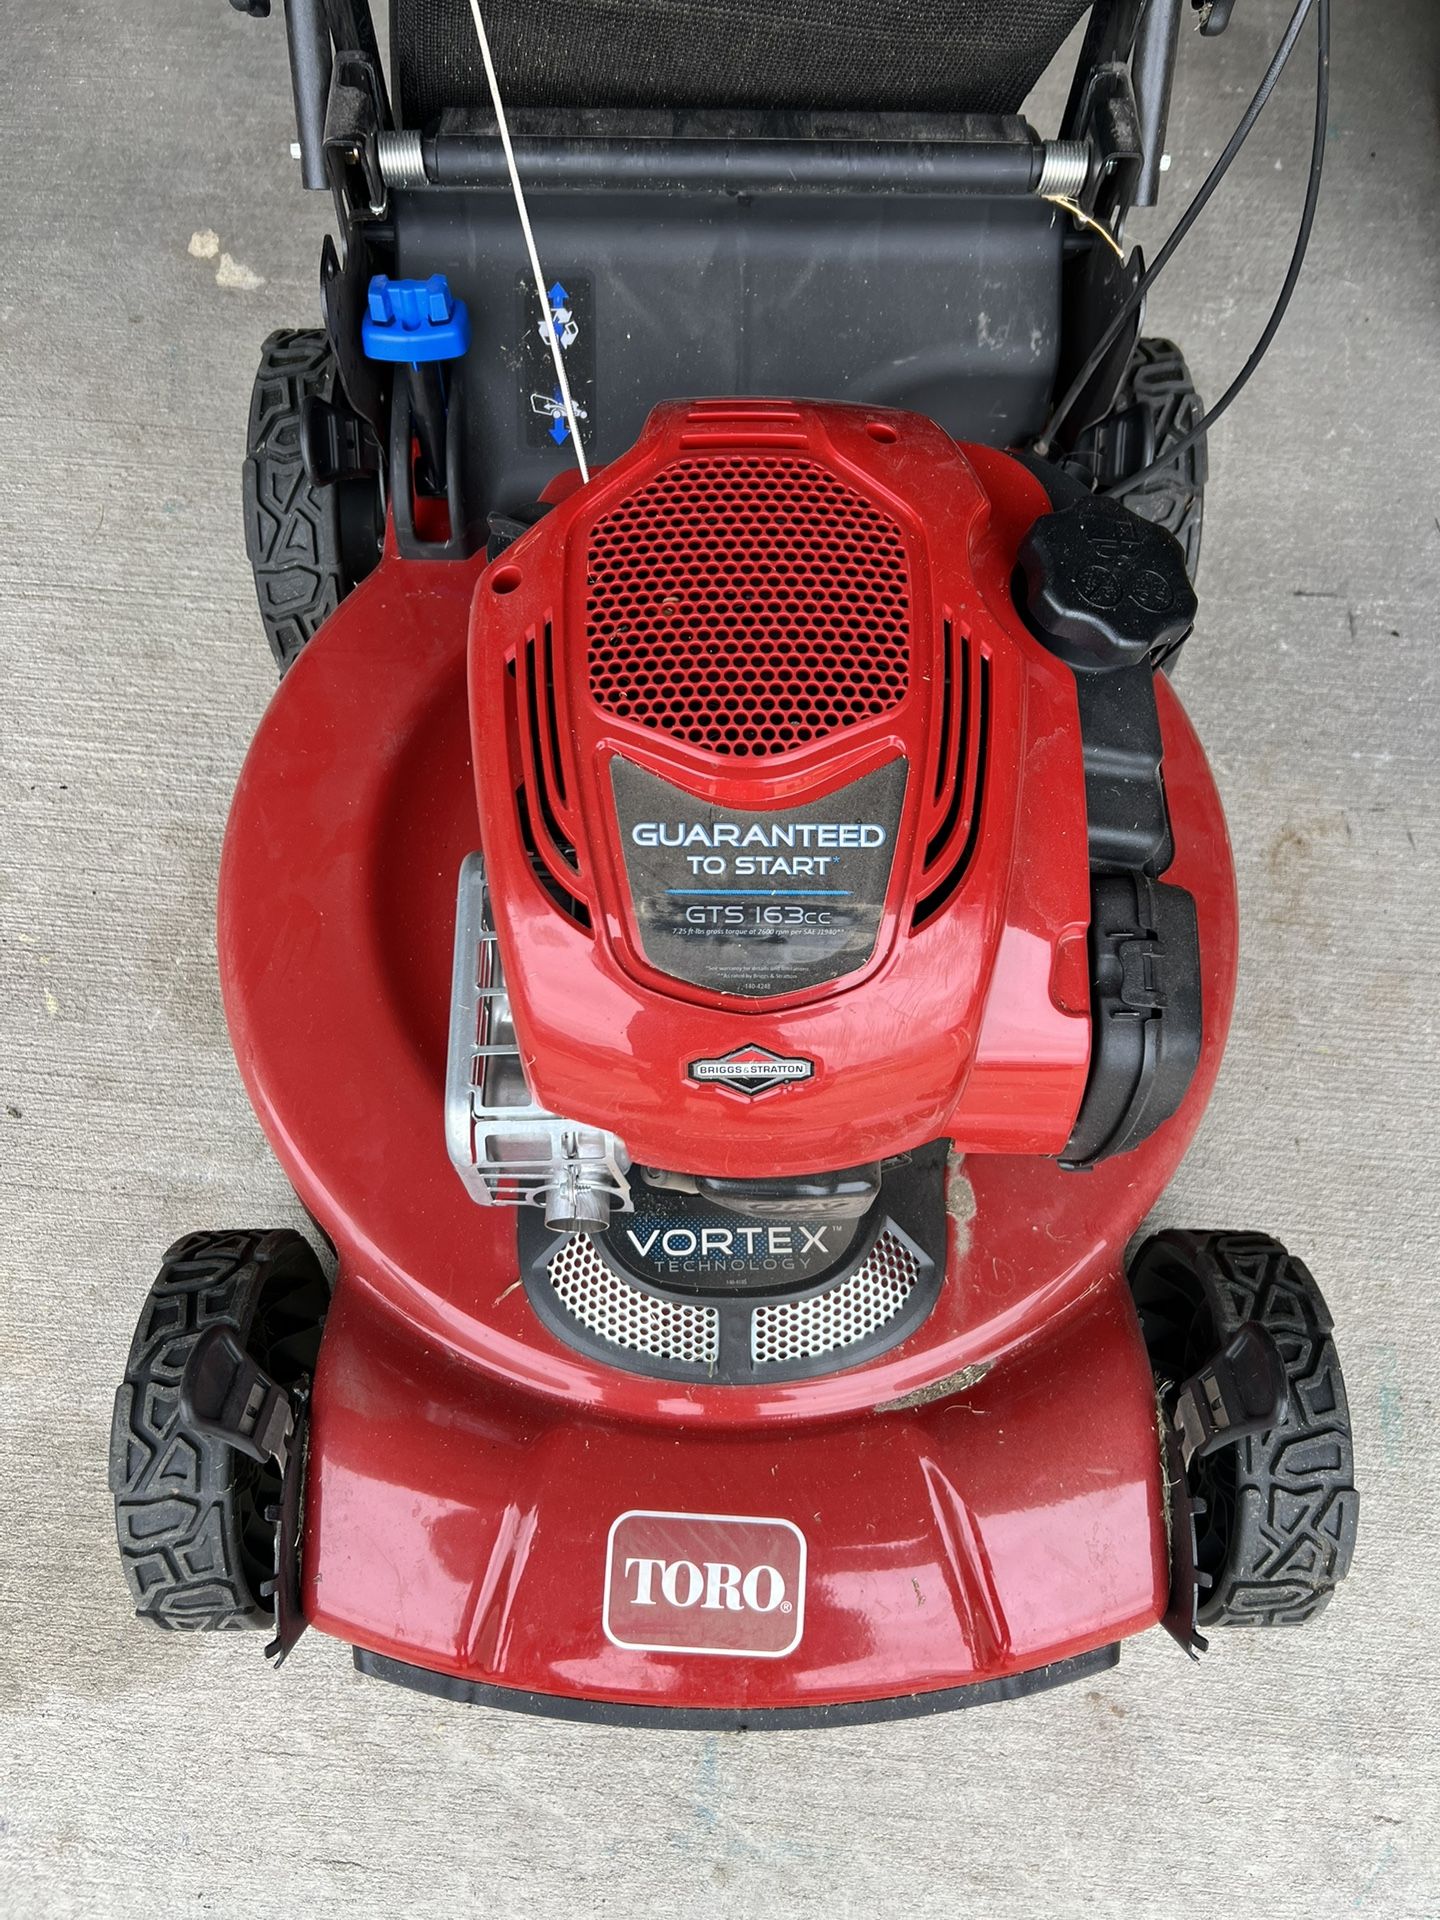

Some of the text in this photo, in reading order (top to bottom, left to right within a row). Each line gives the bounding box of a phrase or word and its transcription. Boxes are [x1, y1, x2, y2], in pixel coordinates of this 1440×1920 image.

[632, 823, 886, 848] GUARANTEED
[687, 855, 726, 875] TO
[686, 905, 831, 925] GTS 163cc
[672, 927, 687, 935] 7.25
[706, 929, 724, 937] gross
[725, 928, 748, 937] torque
[753, 973, 769, 981] Briggs
[654, 1258, 812, 1273] TECHNOLOGY
